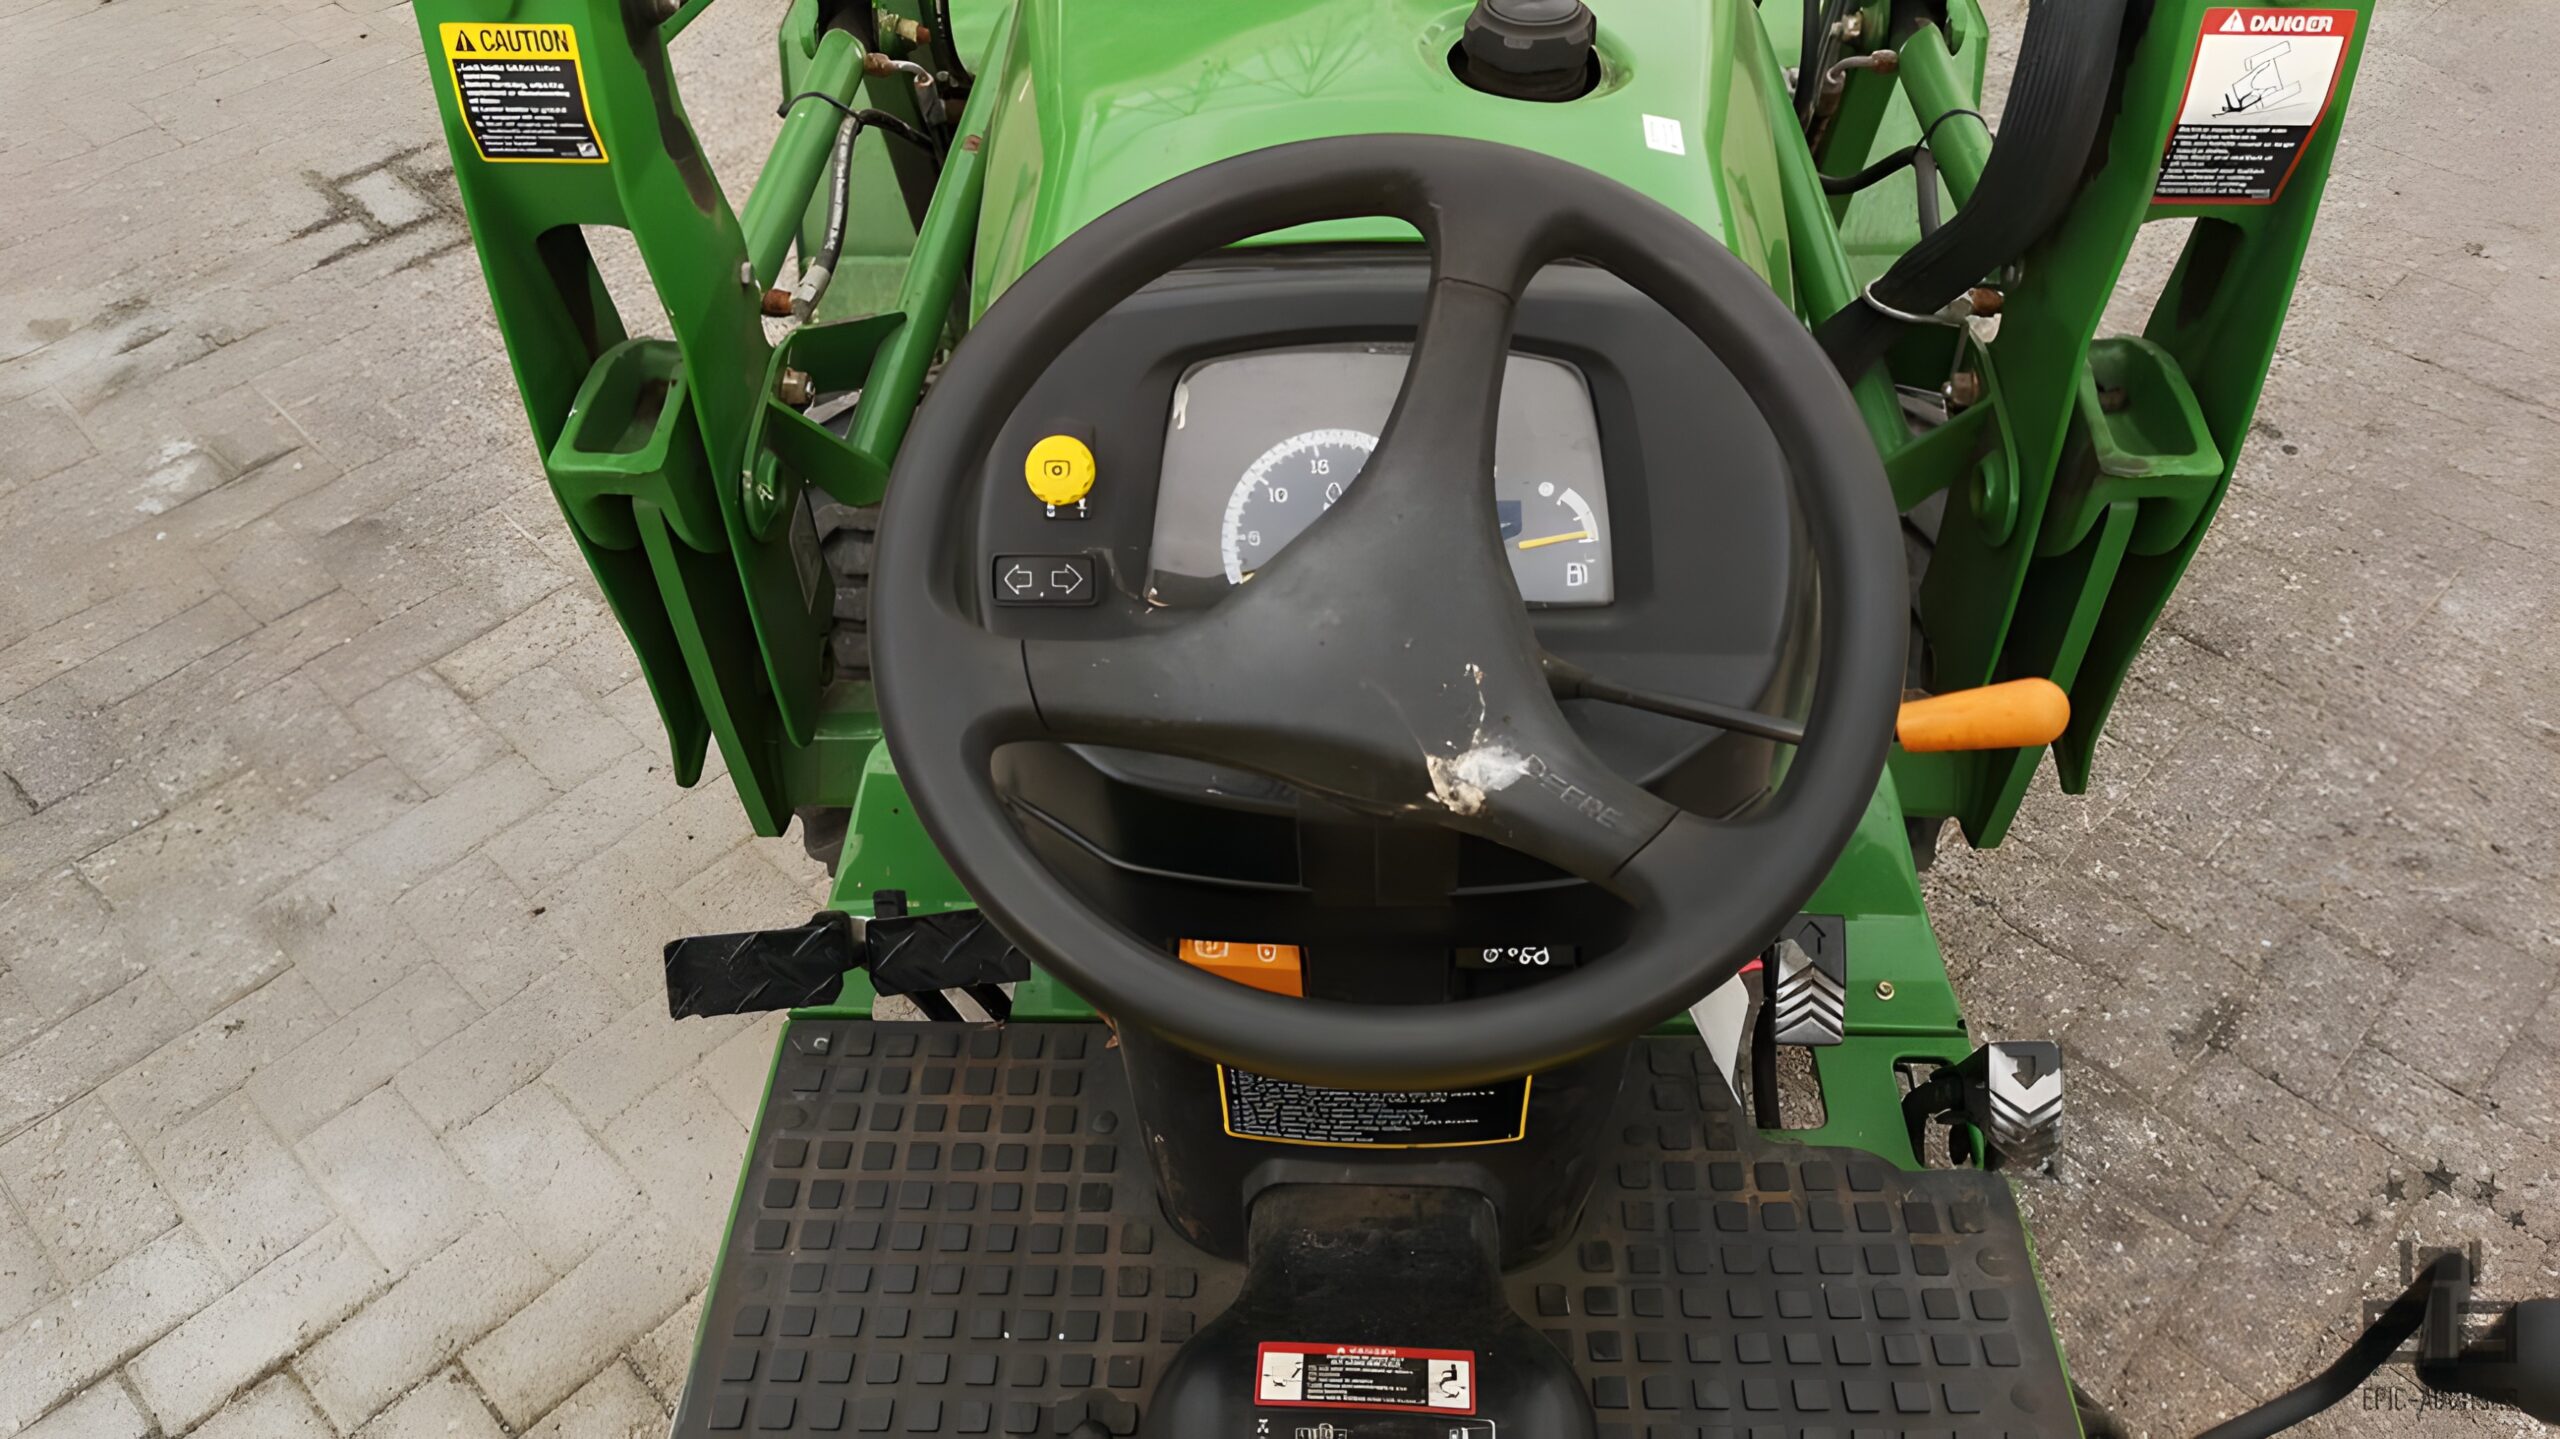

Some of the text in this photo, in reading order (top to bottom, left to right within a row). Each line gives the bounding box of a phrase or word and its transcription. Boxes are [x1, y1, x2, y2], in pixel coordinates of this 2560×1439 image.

[2250, 15, 2334, 33] DANGER
[479, 29, 570, 52] CAUTION
[1268, 487, 1289, 503] 10
